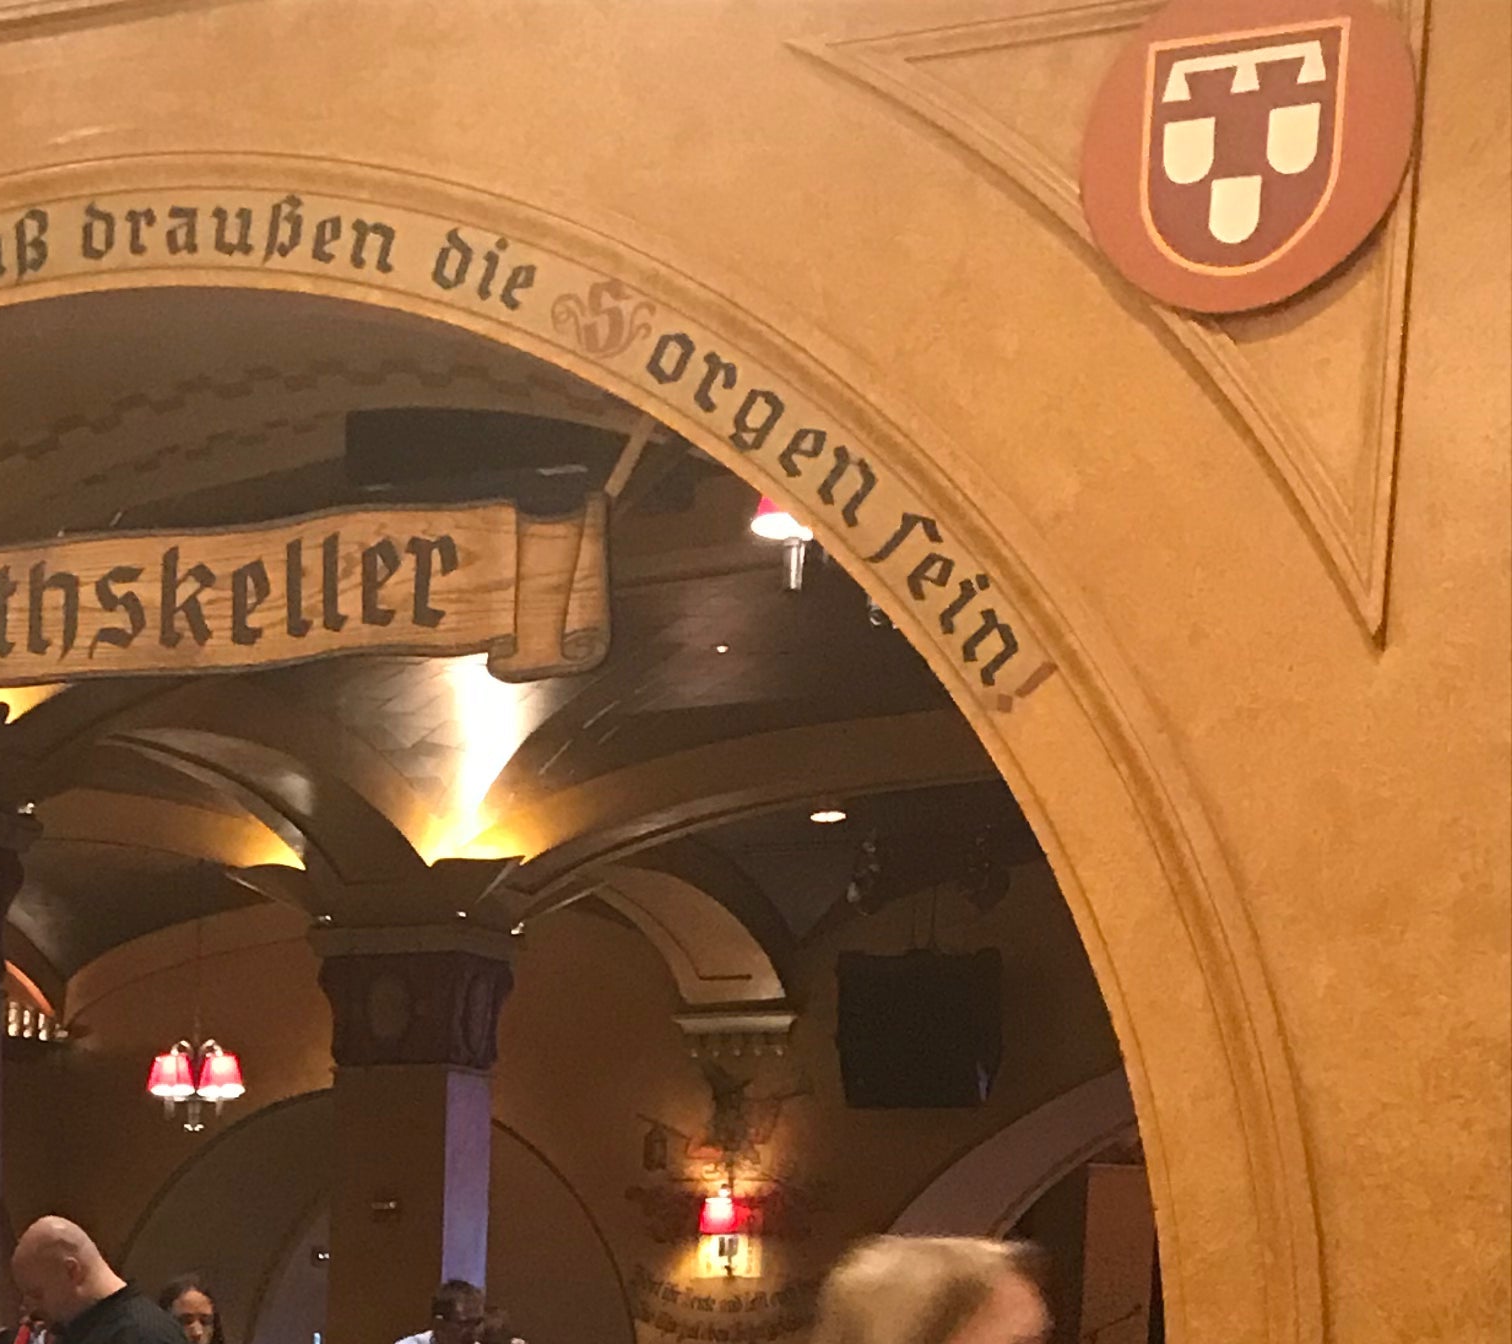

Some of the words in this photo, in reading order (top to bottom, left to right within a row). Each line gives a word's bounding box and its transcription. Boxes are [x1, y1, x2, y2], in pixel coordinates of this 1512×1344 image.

[81, 194, 396, 274] draußen
[431, 226, 538, 311] die
[550, 277, 879, 528] Sorgen
